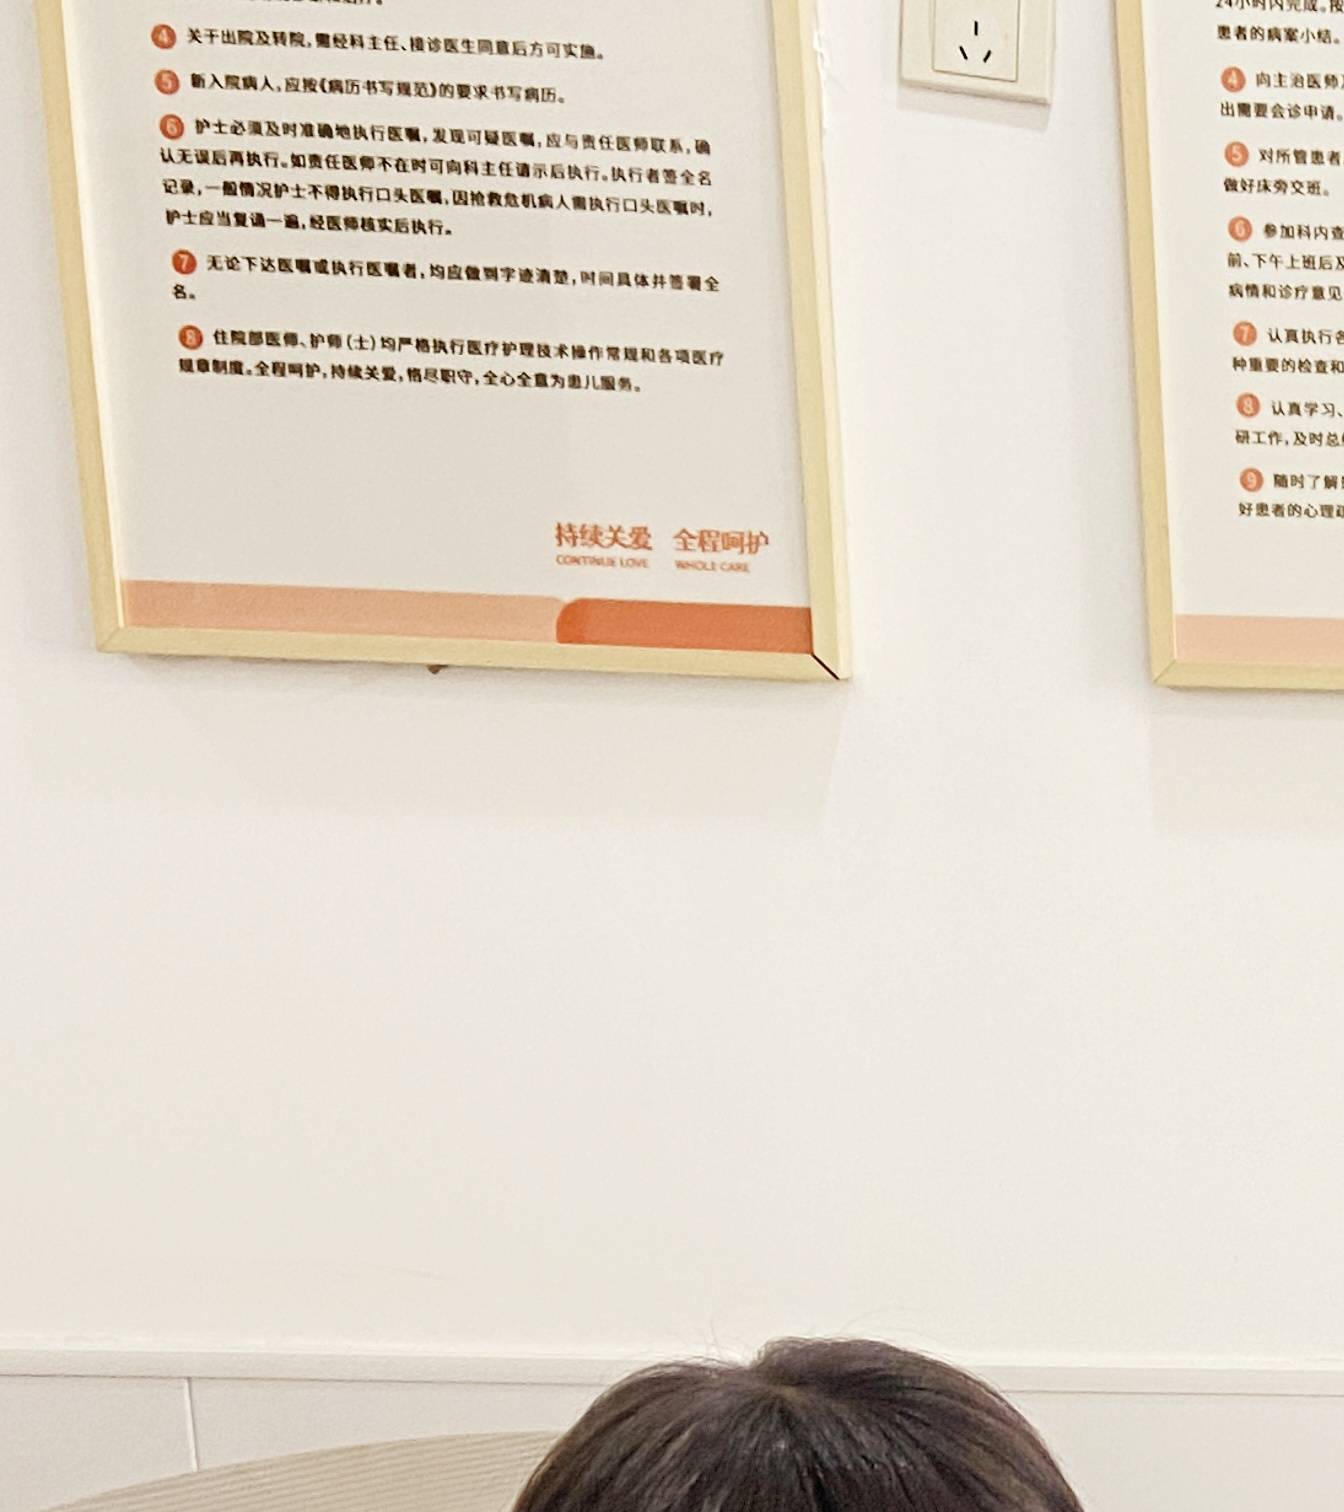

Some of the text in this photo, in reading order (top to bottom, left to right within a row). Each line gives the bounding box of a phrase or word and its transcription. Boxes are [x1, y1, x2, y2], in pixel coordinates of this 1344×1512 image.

[555, 522, 769, 555] 持续关爱 全程呵护
[555, 554, 750, 573] CONTINUE LOVE WHOLE CARE
